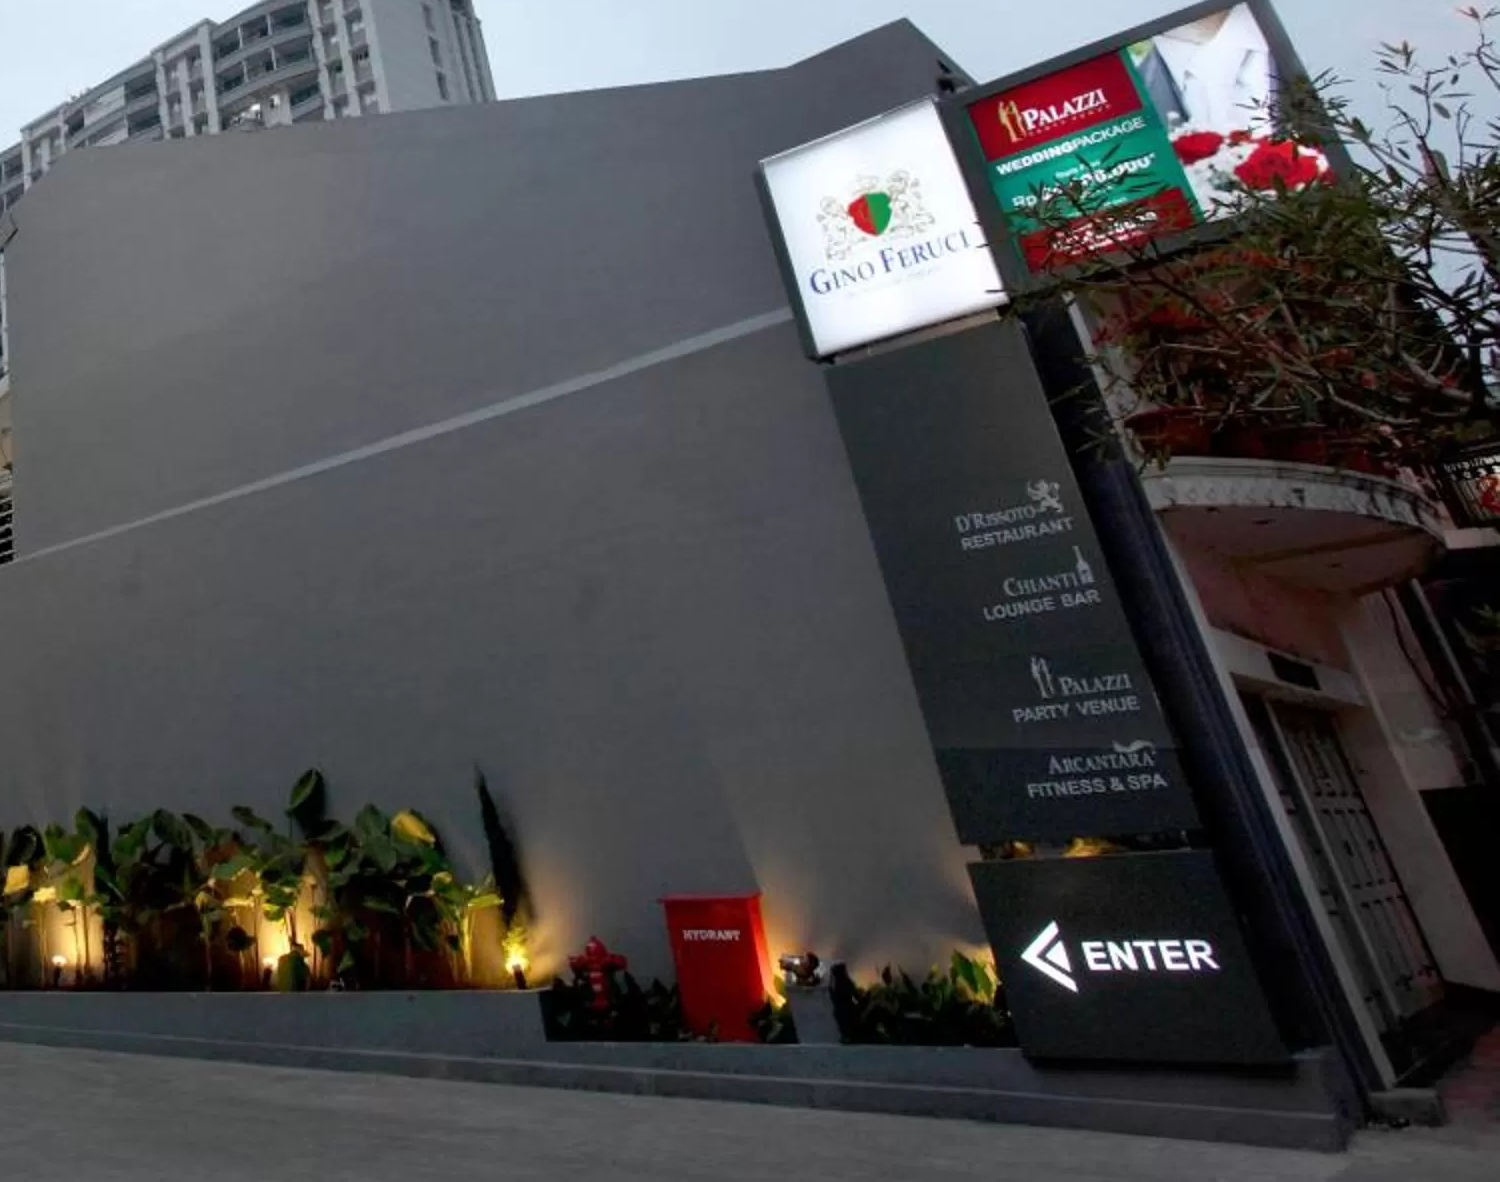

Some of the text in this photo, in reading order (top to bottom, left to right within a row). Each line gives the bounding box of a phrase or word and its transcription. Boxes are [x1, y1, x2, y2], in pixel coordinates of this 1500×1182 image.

[1021, 88, 1108, 130] PALAZZI
[809, 261, 875, 295] GINO
[880, 230, 970, 274] FERUCI
[961, 517, 1075, 550] RESTAURANT
[982, 589, 1102, 622] LOUNGE BAR
[1058, 673, 1133, 696] PALAZZI
[1012, 695, 1141, 723] PARTY VENUE
[1027, 773, 1169, 799] FITNESS & SPA
[682, 929, 741, 942] HYDRANT
[1081, 939, 1221, 971] ENTER
